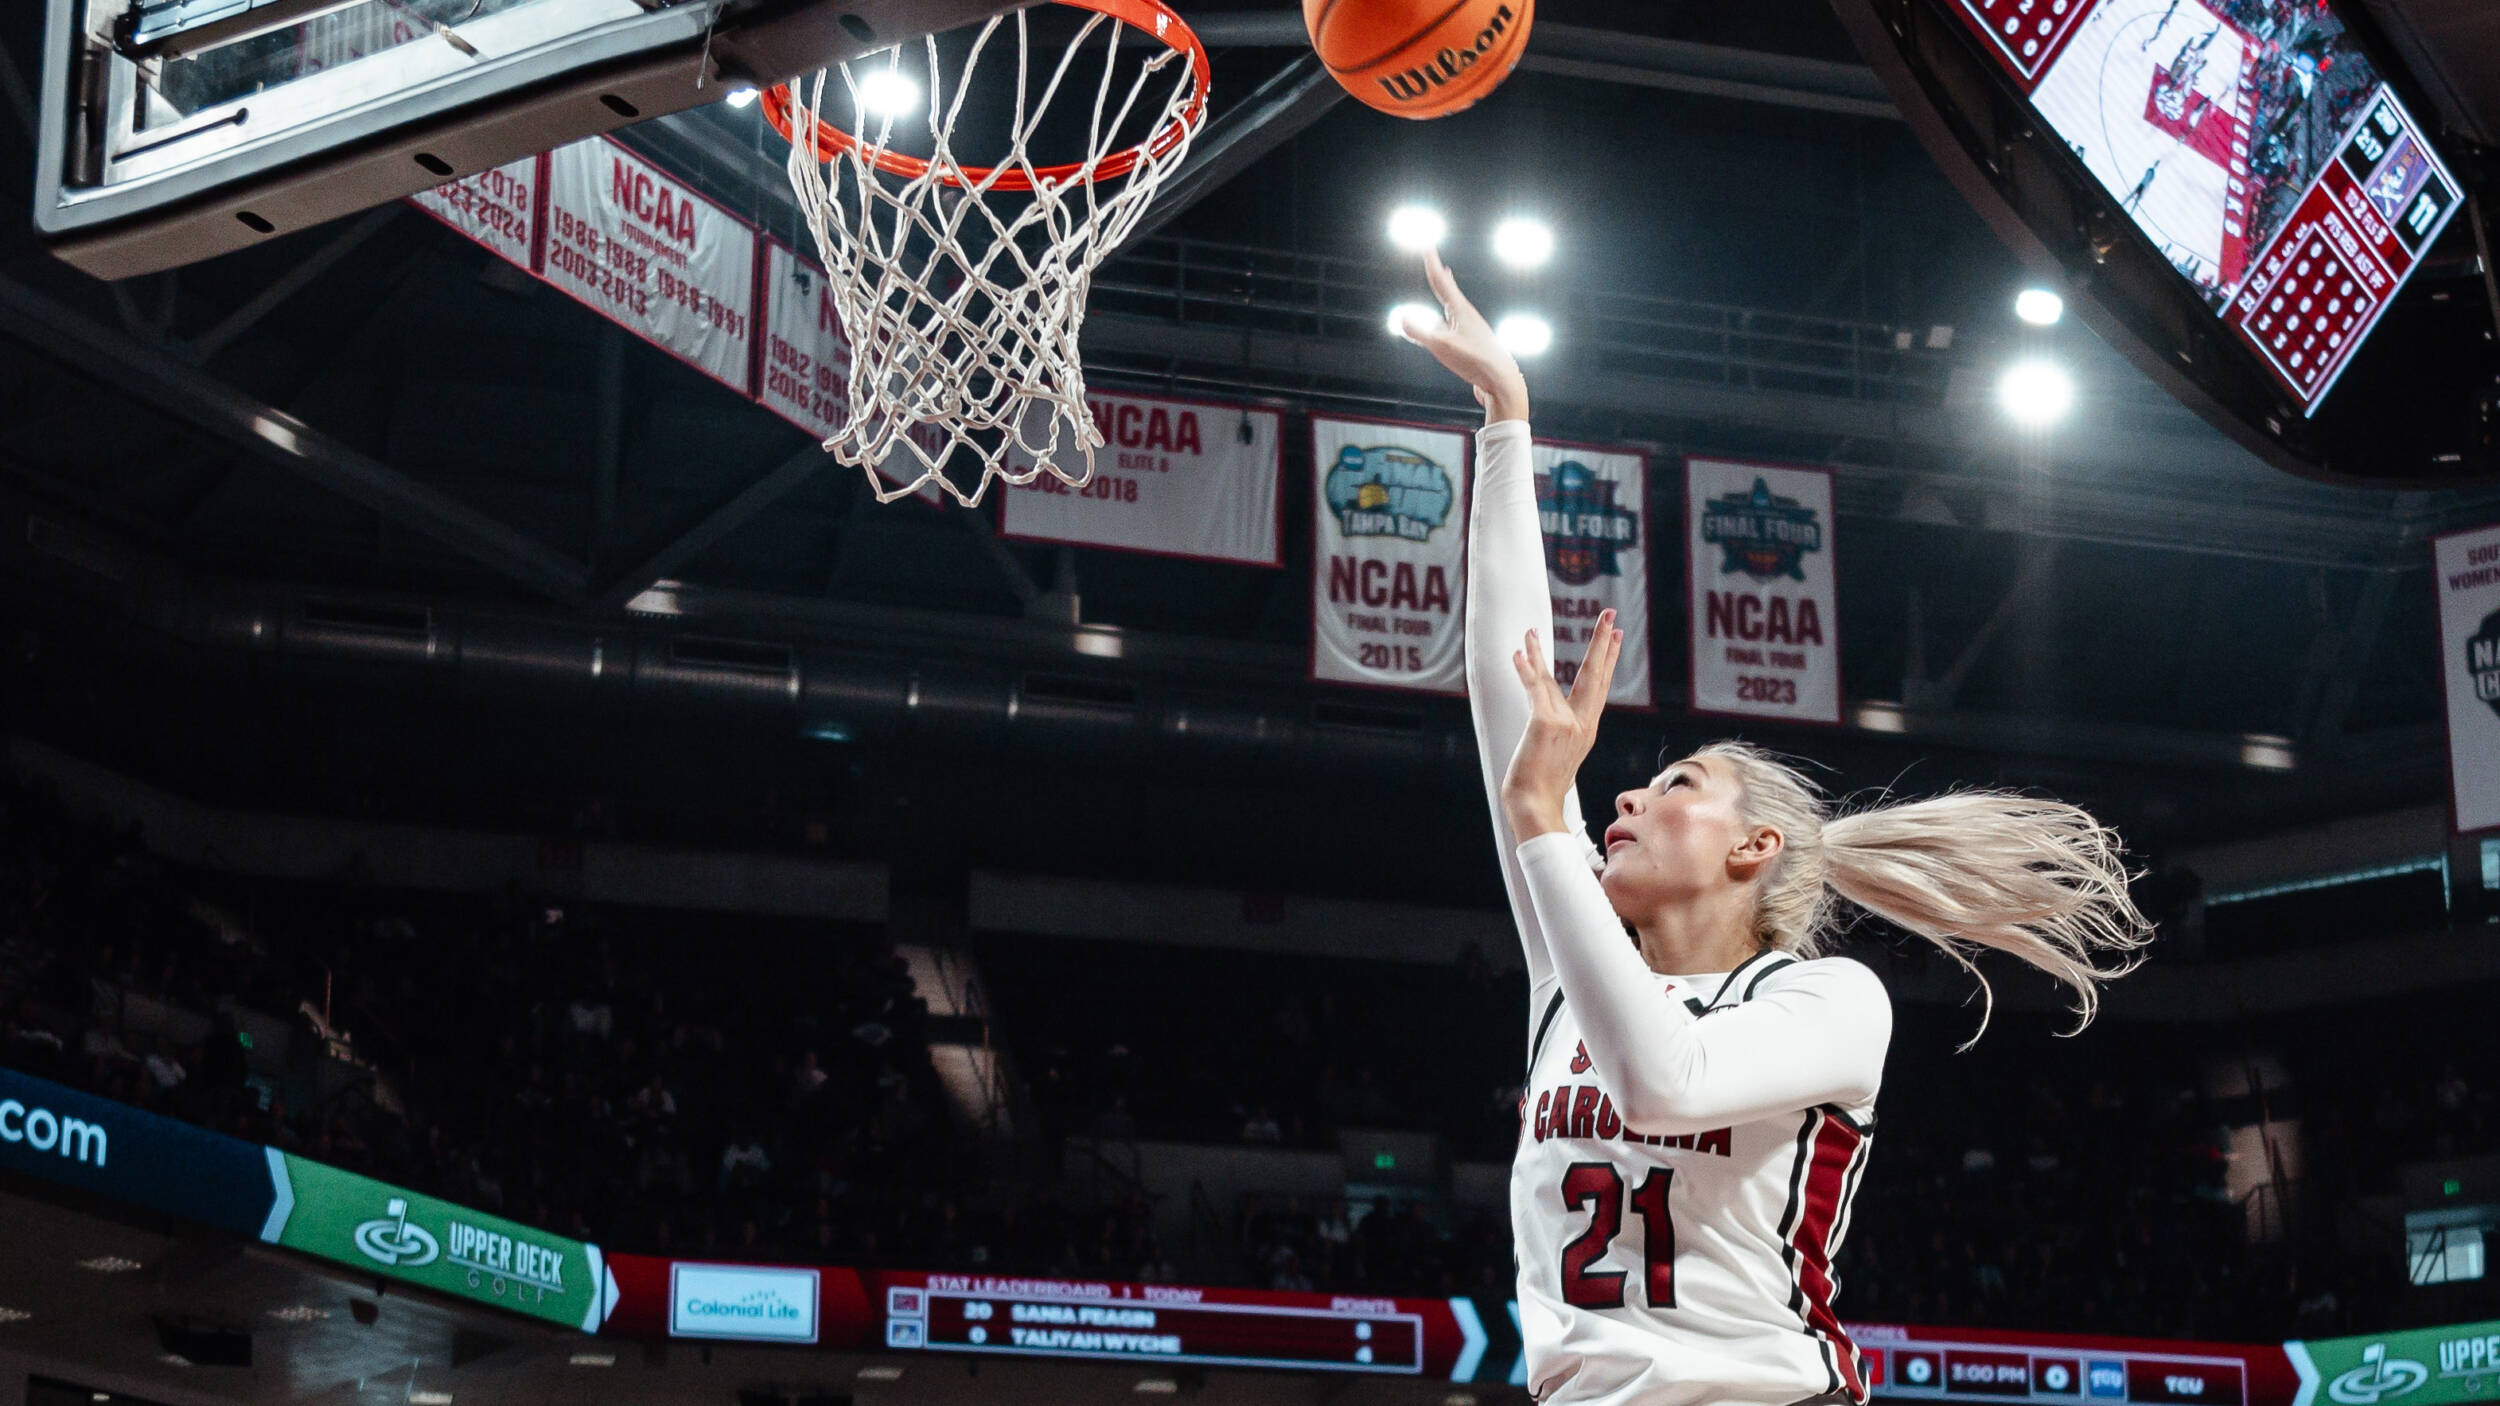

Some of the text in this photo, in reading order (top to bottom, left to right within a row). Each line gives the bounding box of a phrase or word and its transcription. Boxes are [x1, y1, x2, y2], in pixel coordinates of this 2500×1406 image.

[2004, 16, 2020, 35] 0
[2023, 38, 2038, 57] 0
[2037, 18, 2053, 36] 0
[1376, 4, 1513, 101] Wilson
[2354, 126, 2384, 162] 2:17
[477, 195, 527, 246] 2024
[613, 157, 696, 251] NCAA
[2352, 199, 2368, 220] 2
[2374, 226, 2389, 246] 5
[2408, 192, 2439, 236] 11
[554, 205, 599, 255] 1986
[621, 218, 689, 272] TOURNAMENT
[2323, 211, 2386, 290] PTS REB AST PF
[550, 238, 647, 317] 2003 2013
[2297, 260, 2310, 277] 0
[2328, 298, 2341, 315] 0
[2310, 241, 2323, 259] 0
[2325, 260, 2338, 277] 0
[2340, 280, 2353, 297] 0
[2353, 296, 2367, 313] 0
[2251, 272, 2269, 295] 22
[2270, 296, 2284, 313] 0
[2286, 314, 2300, 332] 0
[2284, 277, 2297, 295] 0
[2299, 296, 2312, 313] 0
[2315, 315, 2328, 333] 0
[2328, 331, 2341, 349] 0
[2289, 351, 2303, 368] 0
[1087, 400, 1202, 456] NCAA
[1079, 475, 1138, 503] 2018
[1342, 510, 1395, 537] TAMPA
[1577, 514, 1632, 541] FOUR
[1705, 514, 1815, 549] FINAL FOUR
[1330, 554, 1451, 615] NCAA
[1347, 612, 1432, 638] FINAL FOUR
[1706, 588, 1824, 647] NCAA
[1359, 642, 1422, 673] 2015
[1725, 646, 1808, 671] FINAL FOUR
[1736, 674, 1797, 705] 2023
[450, 1220, 564, 1287] UPPER DECK
[1561, 1162, 1678, 1310] 21
[467, 1268, 545, 1306] GOLF
[928, 1275, 1204, 1303] STAT LEADERBOARD TODAY
[1331, 1296, 1397, 1314] POINTS
[687, 1297, 799, 1320] Colonial Life
[963, 1301, 994, 1321] 20
[1011, 1303, 1078, 1325] SANIA
[1079, 1307, 1156, 1329] FEAGIN
[968, 1325, 988, 1345] 0
[1010, 1327, 1101, 1350] TALIYAH
[1102, 1332, 1181, 1354] WYCHE
[1906, 1357, 1932, 1383] 0
[1996, 1365, 2027, 1385] PM
[2044, 1364, 2070, 1390] 0
[2164, 1375, 2205, 1395] TCU
